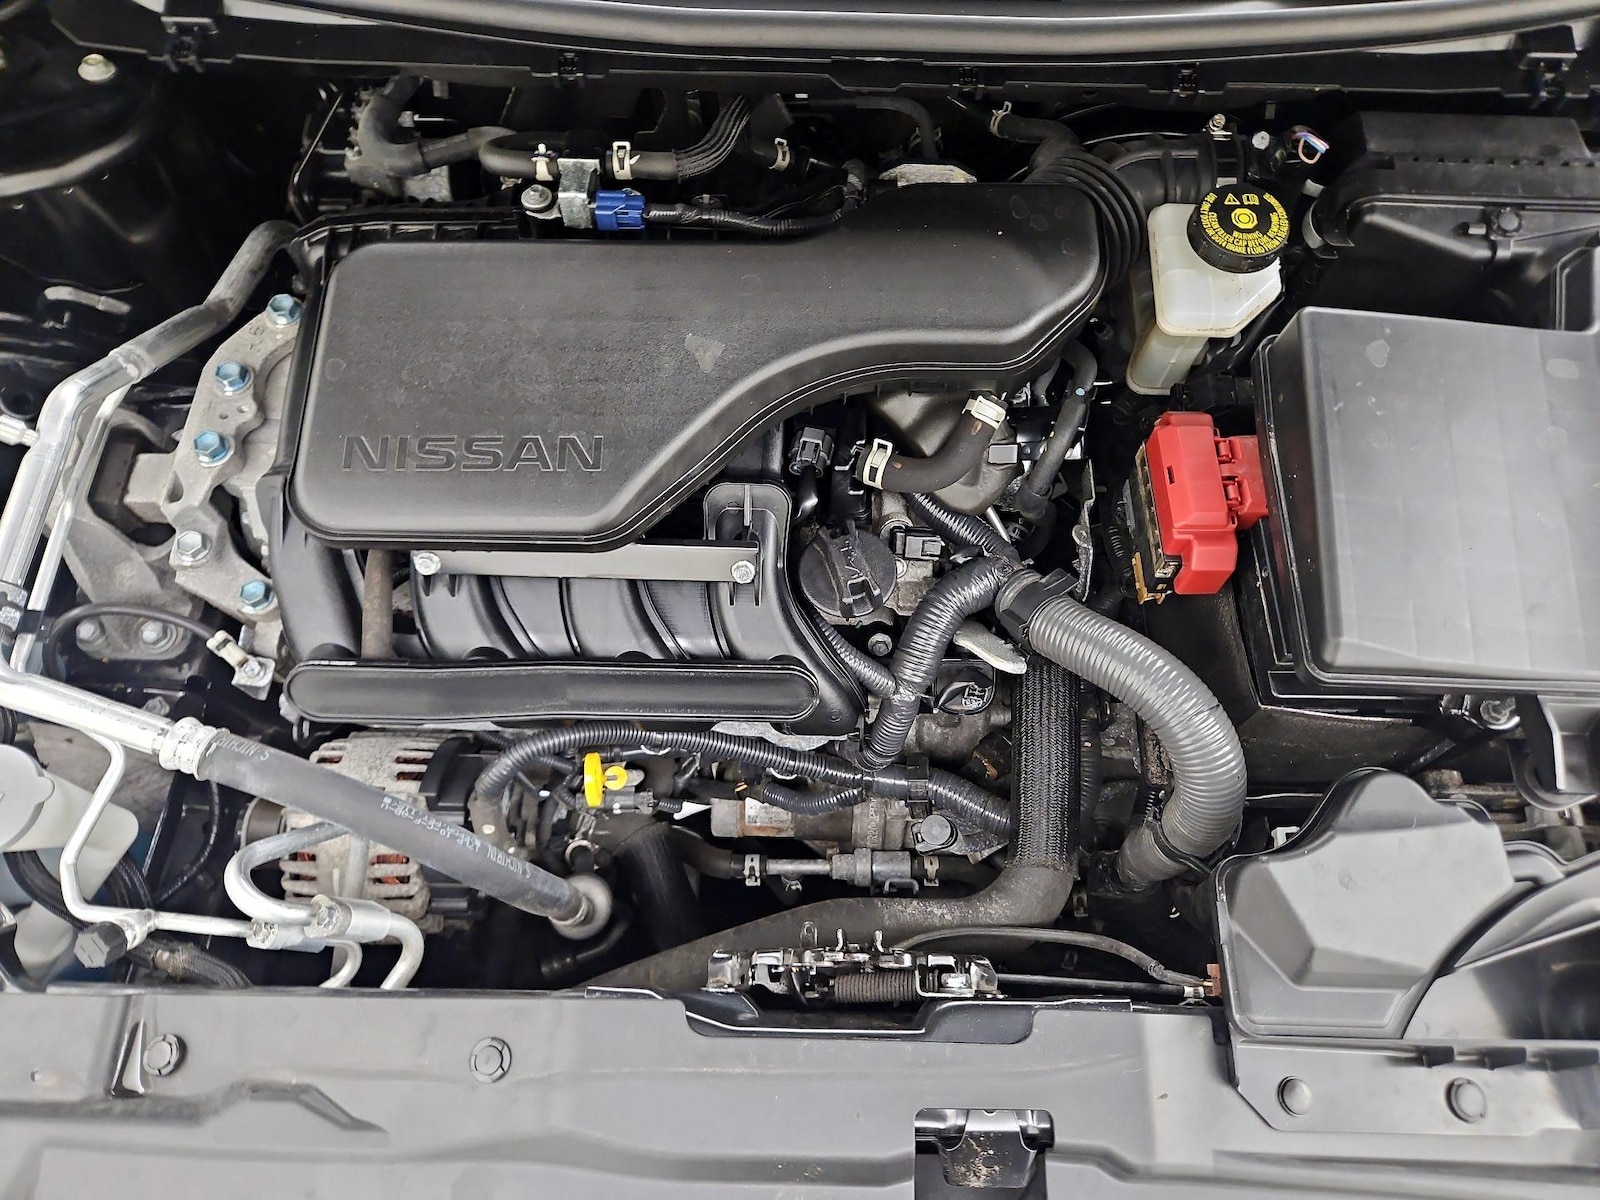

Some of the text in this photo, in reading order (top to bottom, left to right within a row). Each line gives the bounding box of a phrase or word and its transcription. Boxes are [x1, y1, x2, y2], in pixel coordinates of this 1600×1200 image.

[1204, 192, 1218, 203] USE
[1225, 243, 1247, 254] BRAKE
[1247, 246, 1265, 255] FLUID
[1263, 239, 1281, 252] FROM
[1276, 218, 1290, 239] SEALED
[1208, 211, 1280, 248] CLEAN FILLER CAP BEFORE REMOVING
[1233, 230, 1263, 240] WARNING
[341, 435, 604, 472] NISSAN
